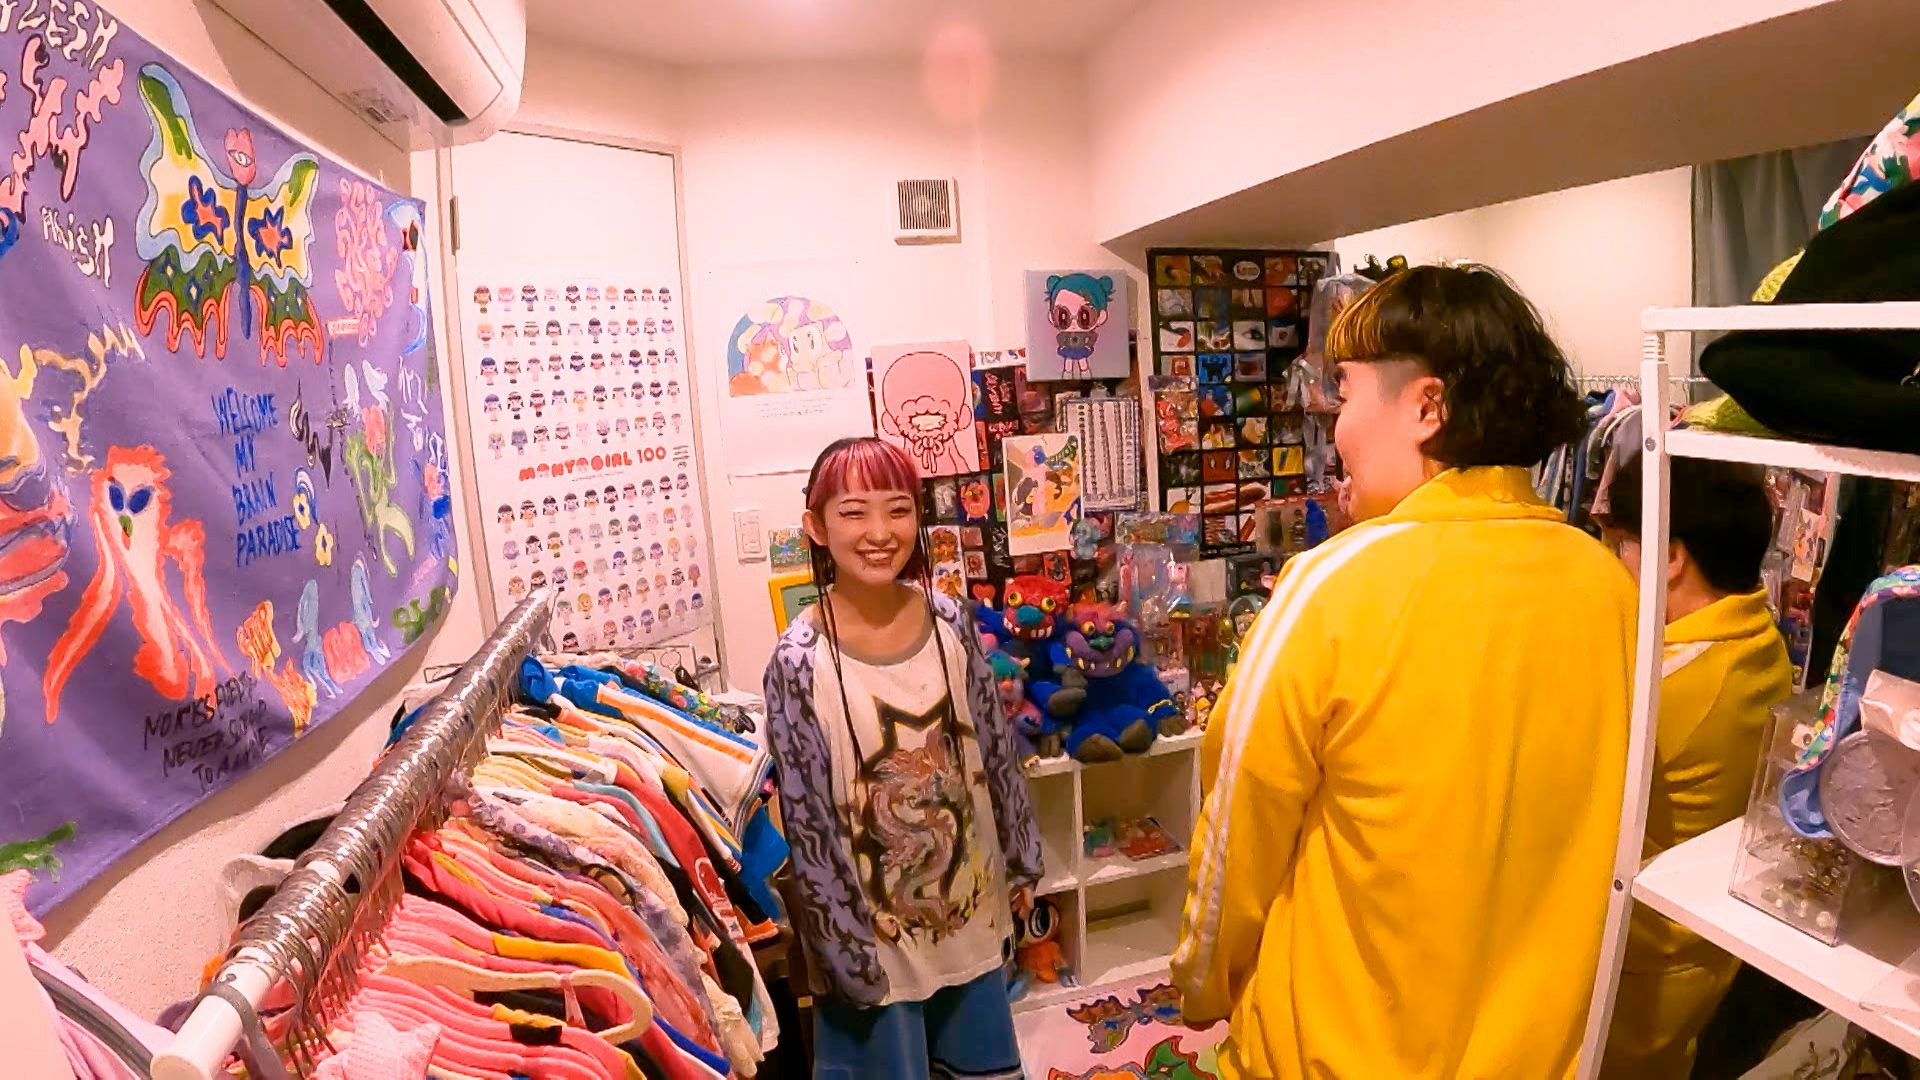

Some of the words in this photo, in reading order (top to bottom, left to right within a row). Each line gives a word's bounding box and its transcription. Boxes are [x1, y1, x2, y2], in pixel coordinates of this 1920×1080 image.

[234, 433, 256, 478] MY
[637, 446, 667, 463] 100
[232, 472, 277, 526] BRAIN
[236, 515, 302, 568] PARADISE
